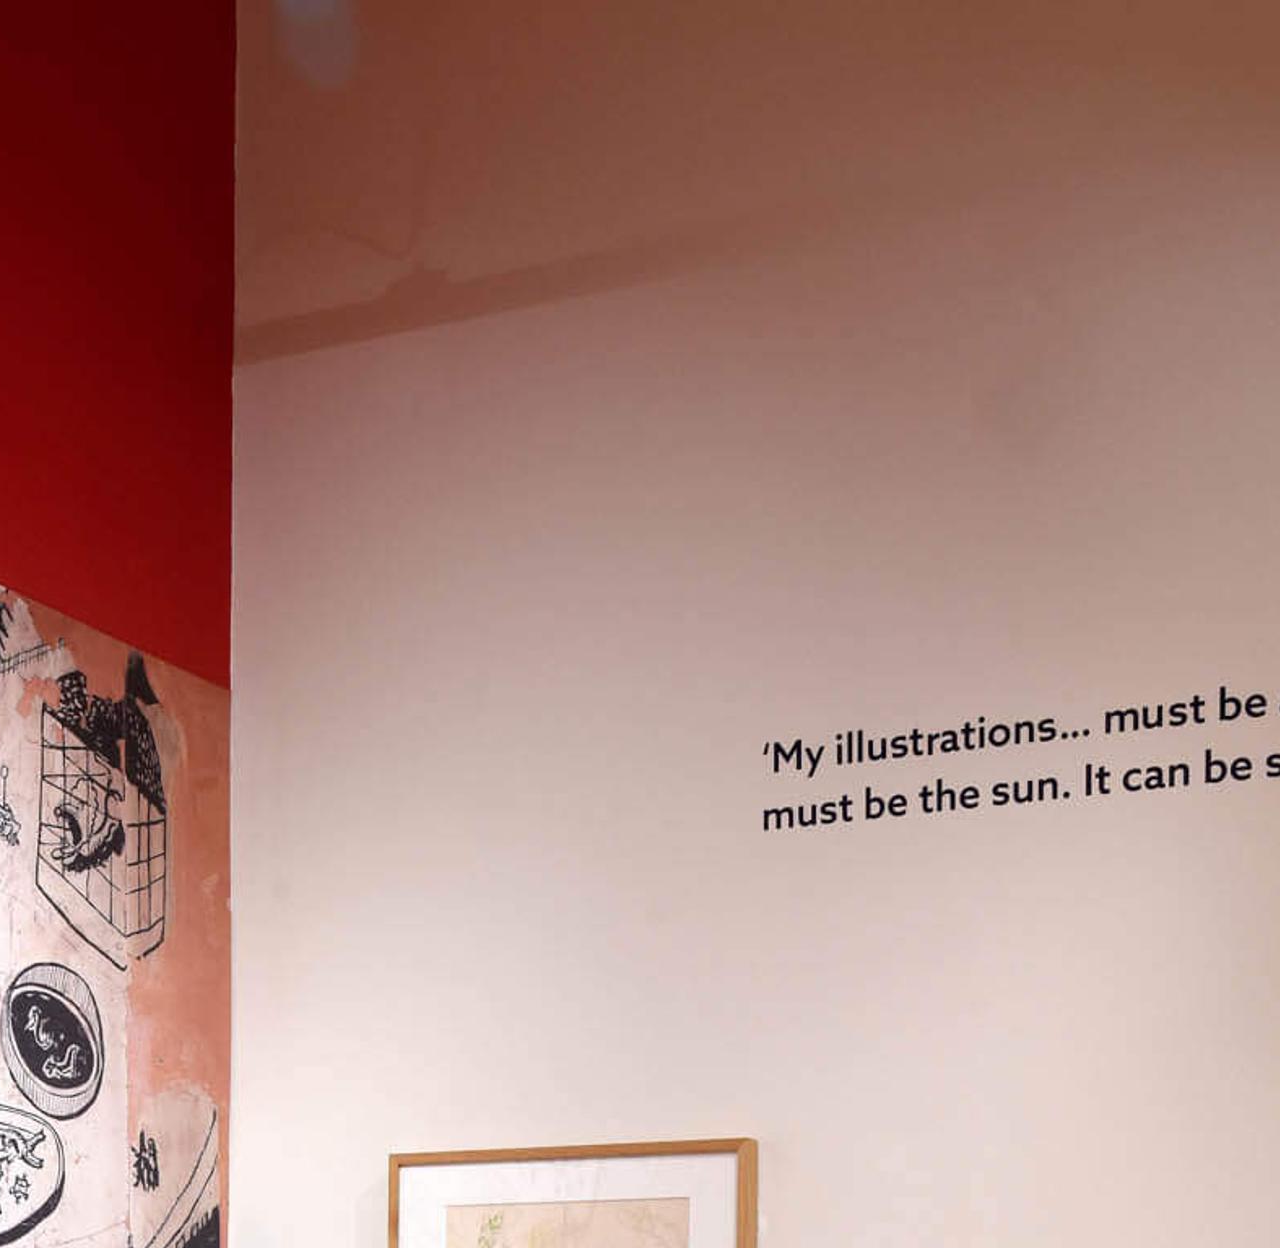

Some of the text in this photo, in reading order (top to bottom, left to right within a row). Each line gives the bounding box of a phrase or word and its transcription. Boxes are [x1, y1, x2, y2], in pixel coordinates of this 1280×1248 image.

[835, 715, 1091, 766] illustrations...
[1104, 694, 1206, 735] must
[1218, 685, 1268, 722] be
[762, 793, 854, 832] must
[864, 785, 908, 821] be
[917, 777, 981, 815] the
[991, 776, 1071, 807] sun.
[1084, 762, 1112, 797] It
[1121, 762, 1191, 793] can
[1203, 748, 1253, 785] be
